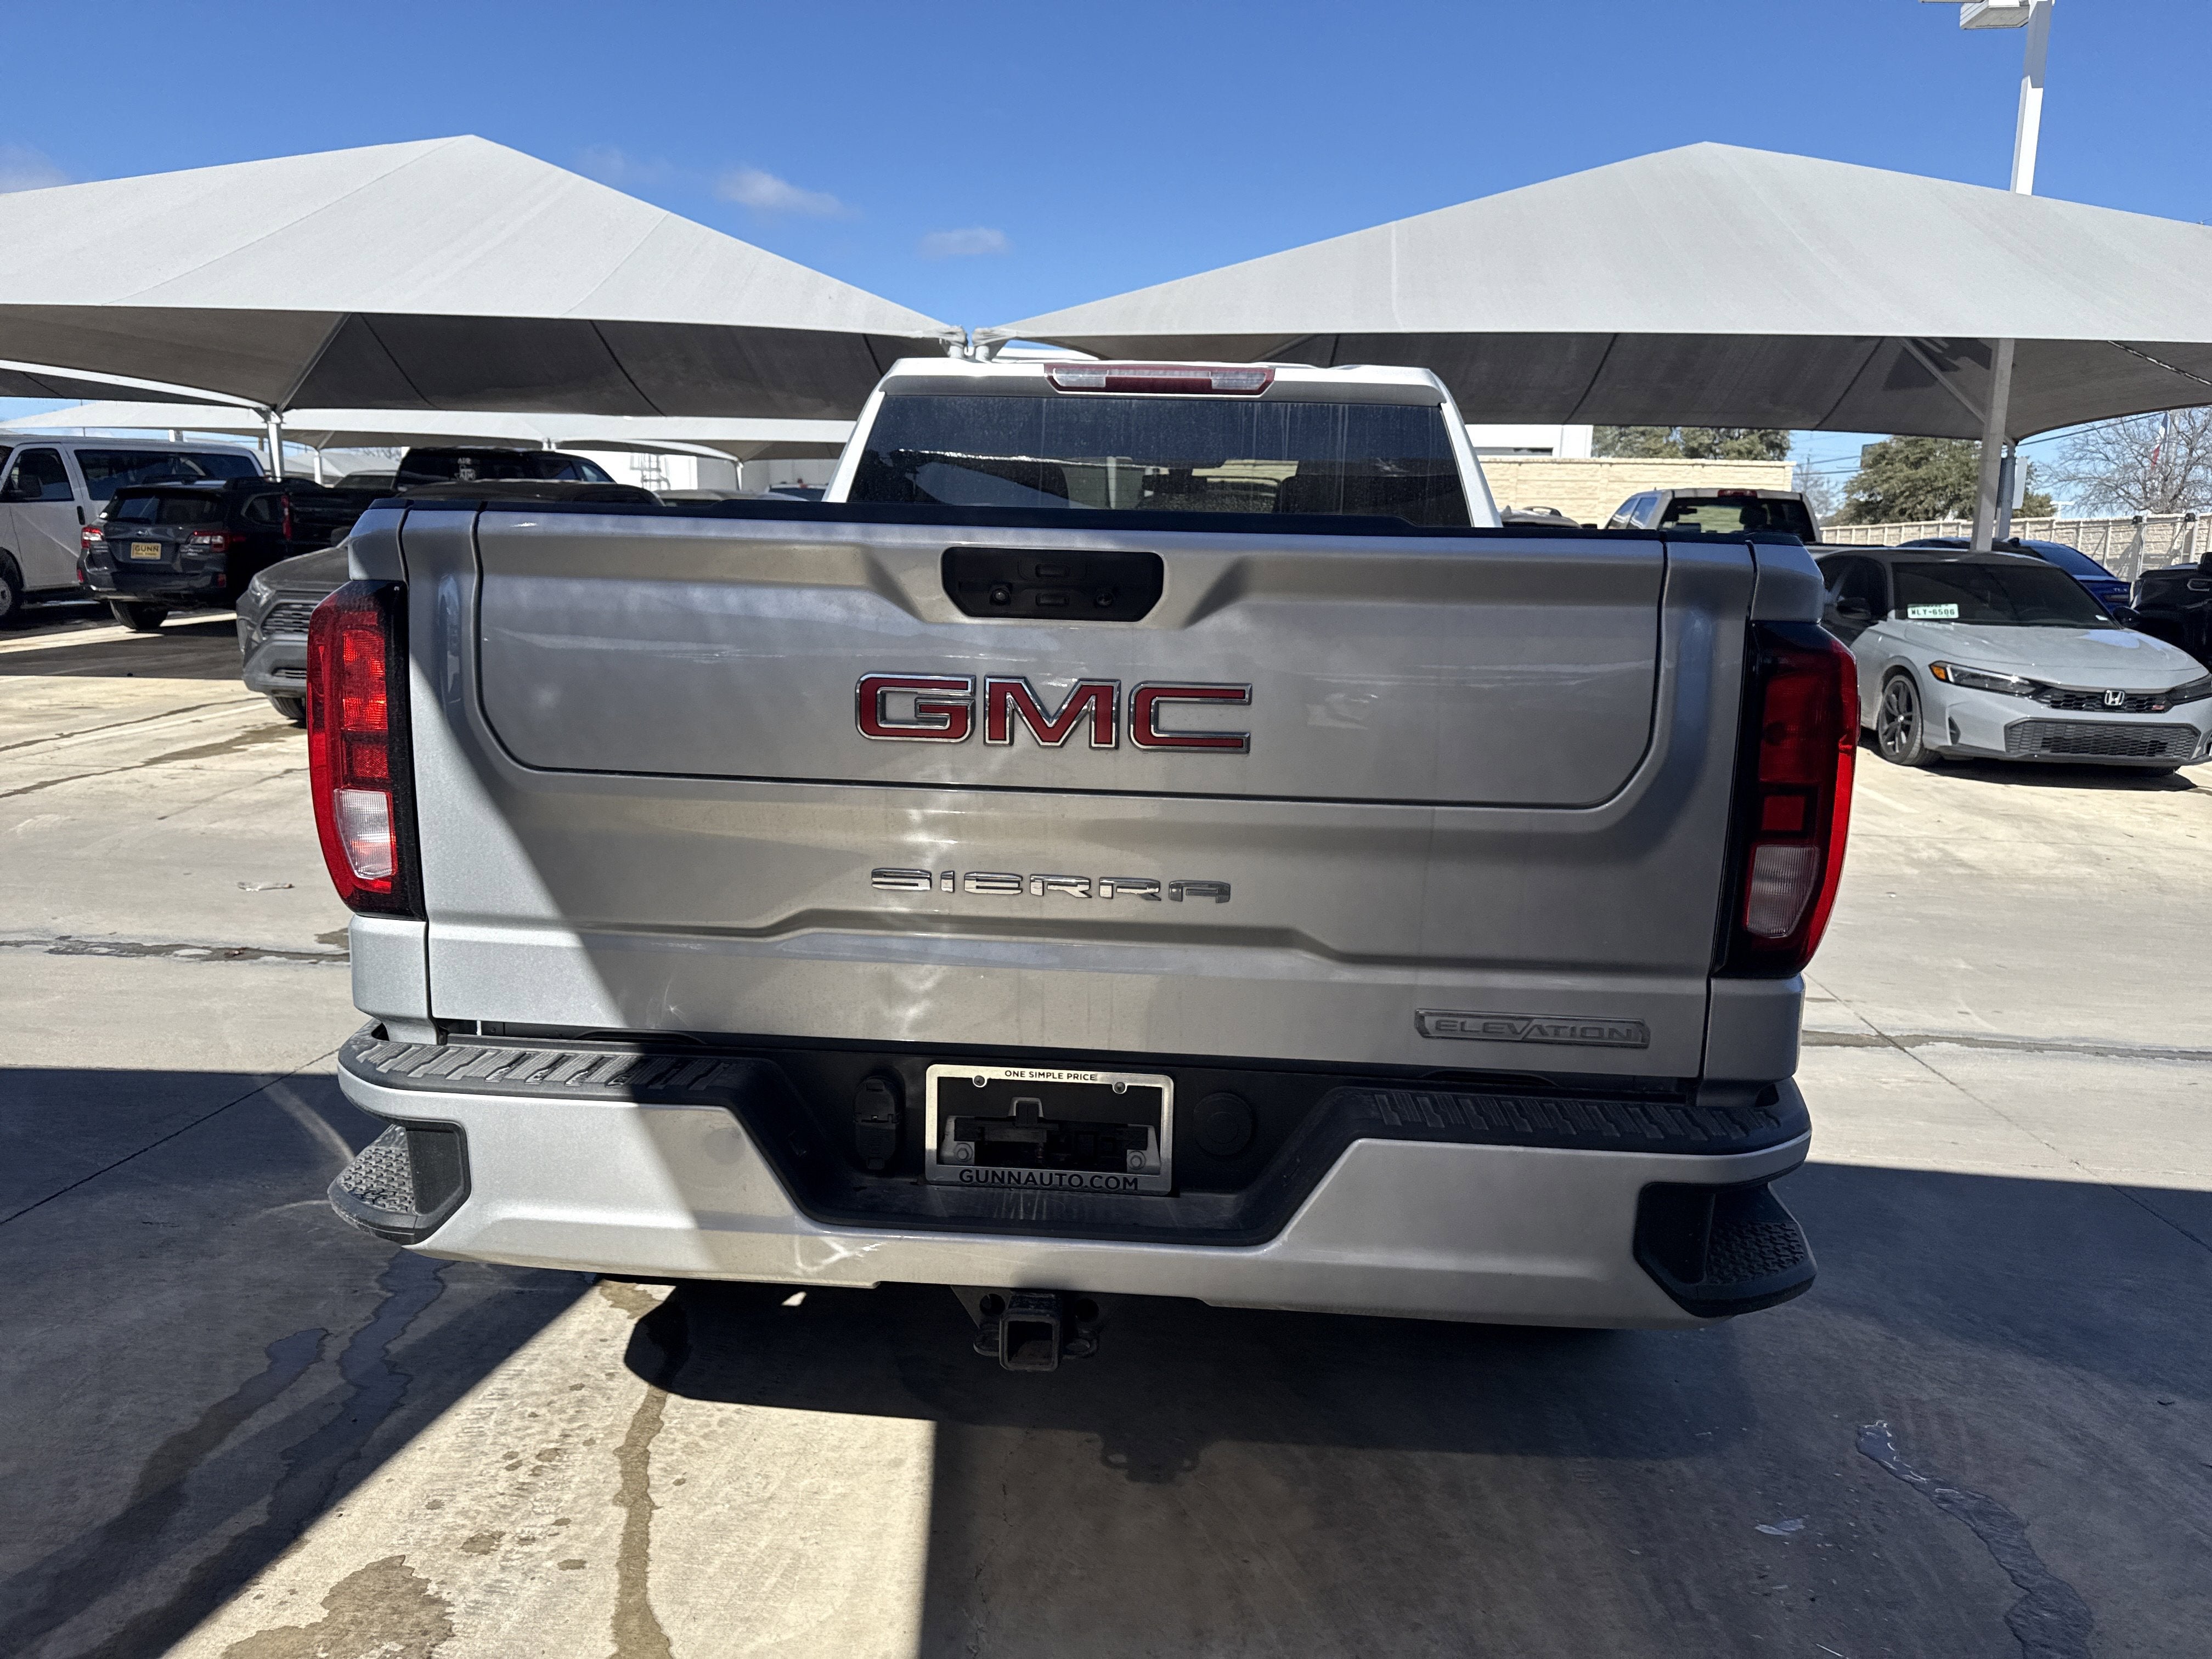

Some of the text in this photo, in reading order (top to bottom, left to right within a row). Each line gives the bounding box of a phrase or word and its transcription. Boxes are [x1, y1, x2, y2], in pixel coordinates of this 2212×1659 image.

[855, 672, 1253, 755] GMC
[870, 867, 1231, 904] SIERRA
[1435, 1019, 1633, 1040] ELEVATION
[1029, 1071, 1064, 1079] SIMPLE
[959, 1169, 1139, 1191] GUNNAUTO.COM
